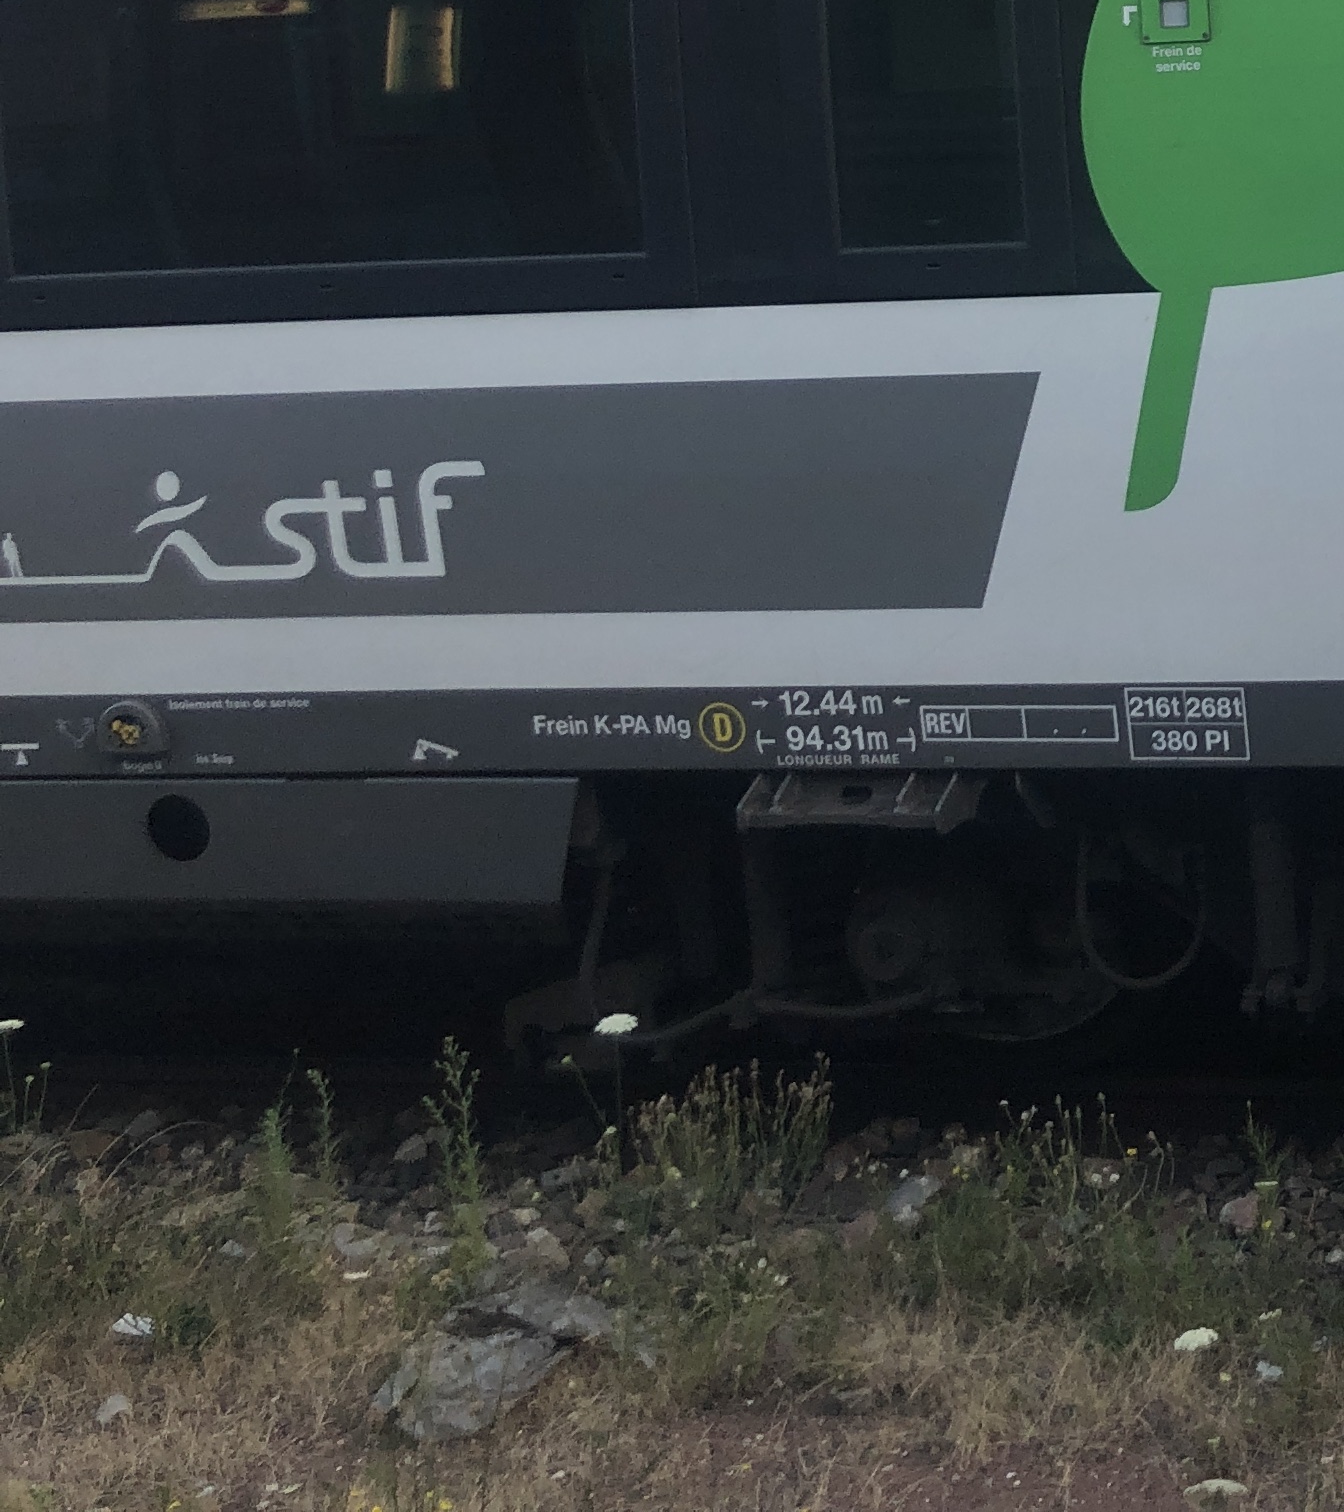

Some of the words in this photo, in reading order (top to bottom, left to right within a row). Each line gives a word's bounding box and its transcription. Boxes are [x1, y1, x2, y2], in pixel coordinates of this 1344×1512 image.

[1152, 46, 1184, 58] Frein
[1186, 45, 1203, 56] de
[1155, 60, 1201, 73] service
[264, 460, 486, 578] stif
[779, 689, 858, 716] 12.44
[861, 694, 884, 715] m
[1130, 696, 1181, 719] 216t
[1187, 696, 1243, 720] 268t
[533, 714, 588, 737] Frein
[594, 714, 651, 736] K-PA
[656, 714, 692, 740] Mg
[713, 713, 733, 742] D
[925, 713, 966, 735] REV
[1151, 730, 1198, 752] 380
[777, 754, 853, 767] LONGUEUR
[860, 753, 900, 766] RAME
